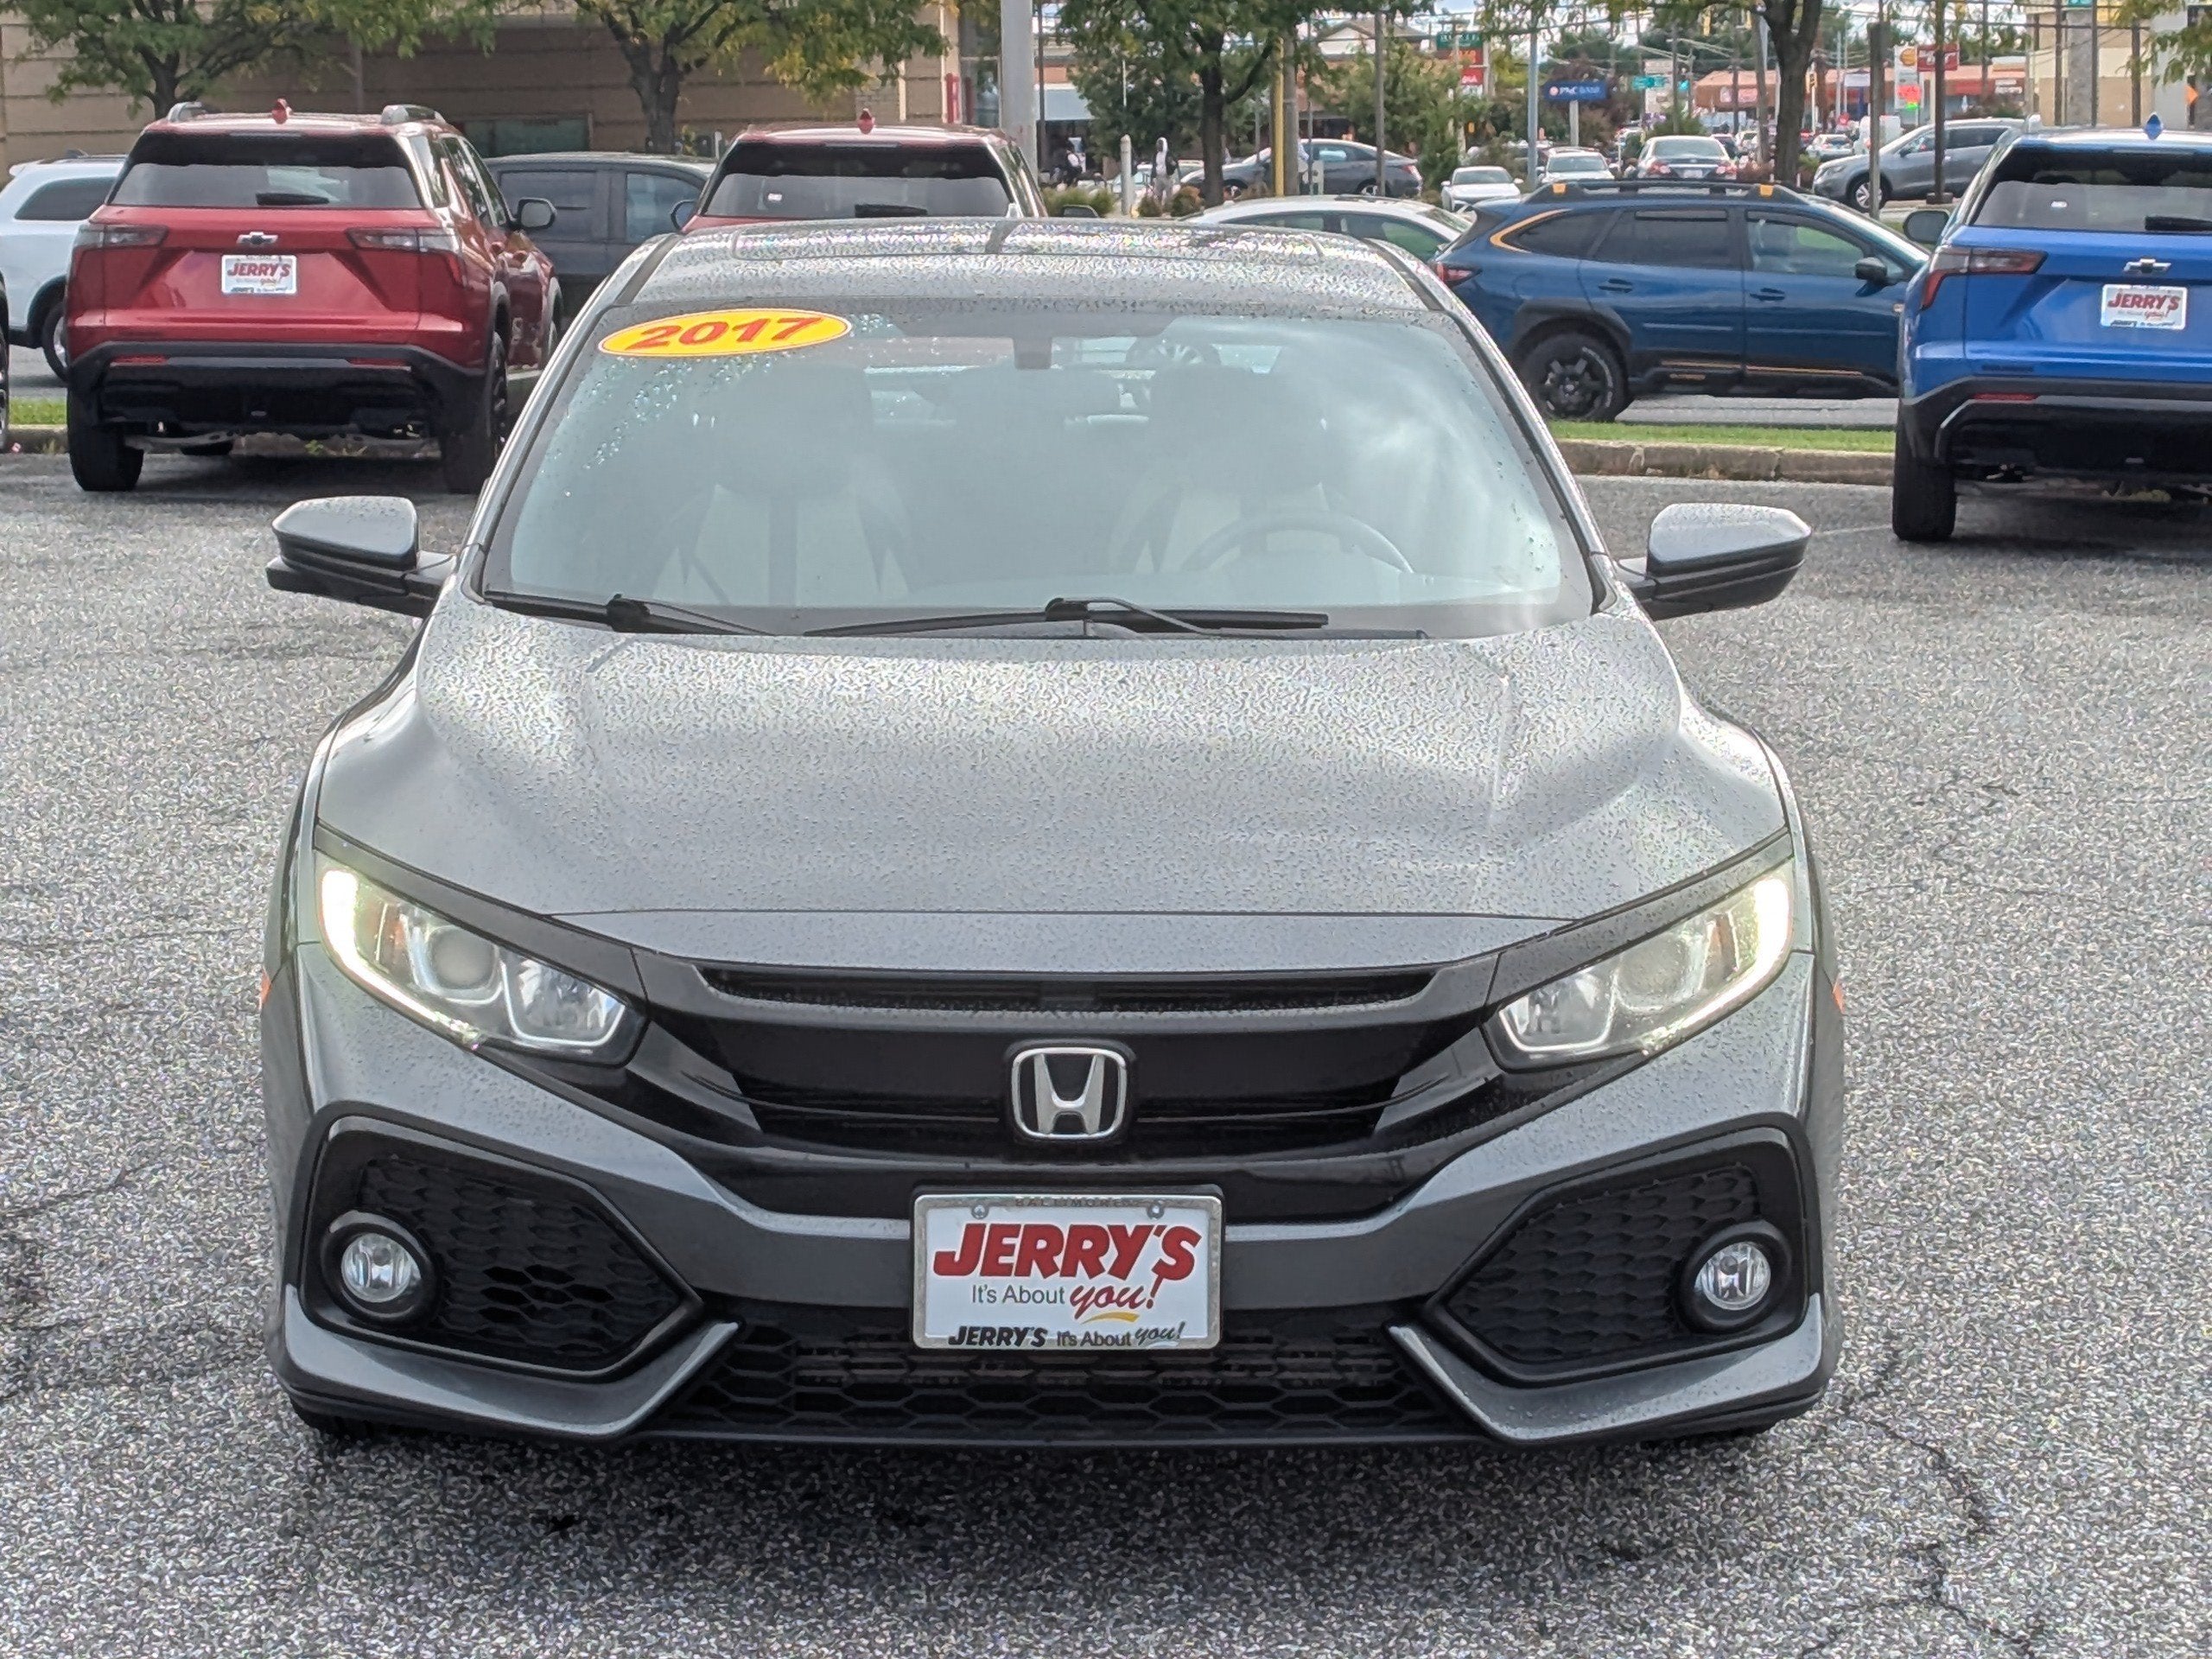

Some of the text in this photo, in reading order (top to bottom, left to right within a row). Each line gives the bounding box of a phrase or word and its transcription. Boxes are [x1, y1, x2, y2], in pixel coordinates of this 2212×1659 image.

[227, 263, 291, 276] JERRY'S
[2107, 293, 2181, 310] JERRY'S
[625, 317, 822, 351] 2017
[933, 1223, 1202, 1281] JERRY'S
[972, 1276, 1164, 1320] It's About you!
[948, 1321, 1185, 1347] JERRY'S It's About you!
